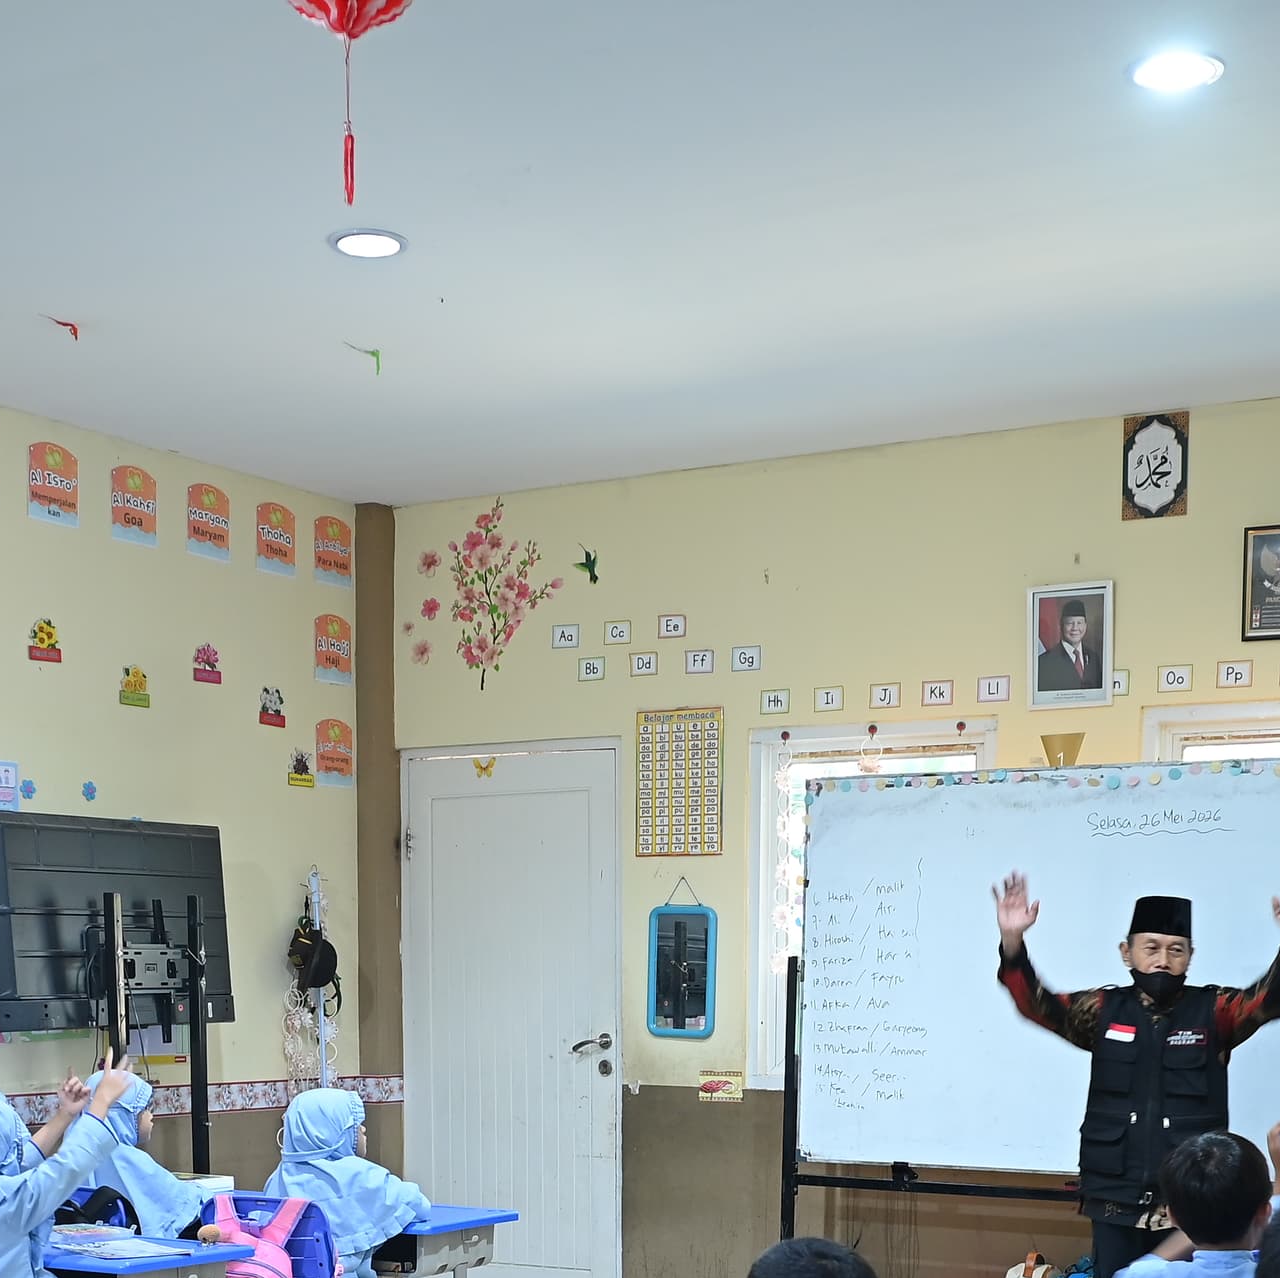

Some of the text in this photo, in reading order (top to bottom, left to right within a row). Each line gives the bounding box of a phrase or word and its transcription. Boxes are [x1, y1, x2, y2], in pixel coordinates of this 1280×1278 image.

[30, 469, 42, 486] Al
[112, 492, 156, 516] Al Kahfi
[47, 506, 61, 518] kan
[123, 512, 143, 527] Goa
[189, 507, 229, 529] Maryam
[192, 525, 225, 543] Maryam
[259, 524, 292, 547] Thoha
[265, 543, 288, 558] Thoha
[317, 555, 332, 567] Para
[610, 625, 625, 639] Cc
[665, 619, 680, 633] Ee
[558, 629, 573, 643] Aa
[317, 636, 350, 657] Al Hajj
[325, 654, 341, 668] Haji
[637, 656, 651, 670] Dd
[692, 654, 708, 668] Ff
[738, 651, 755, 667] Gg
[585, 662, 599, 675] Bb
[1225, 666, 1243, 684] Pp
[1166, 670, 1185, 685] Oo
[879, 688, 892, 705] Jj
[929, 686, 945, 700] Kk
[767, 695, 782, 708] Hh
[644, 711, 715, 723] Belajar membaca
[1057, 751, 1065, 766] 1
[1138, 813, 1161, 830] 26
[1163, 808, 1184, 824] Mei
[1187, 808, 1223, 823] 2026
